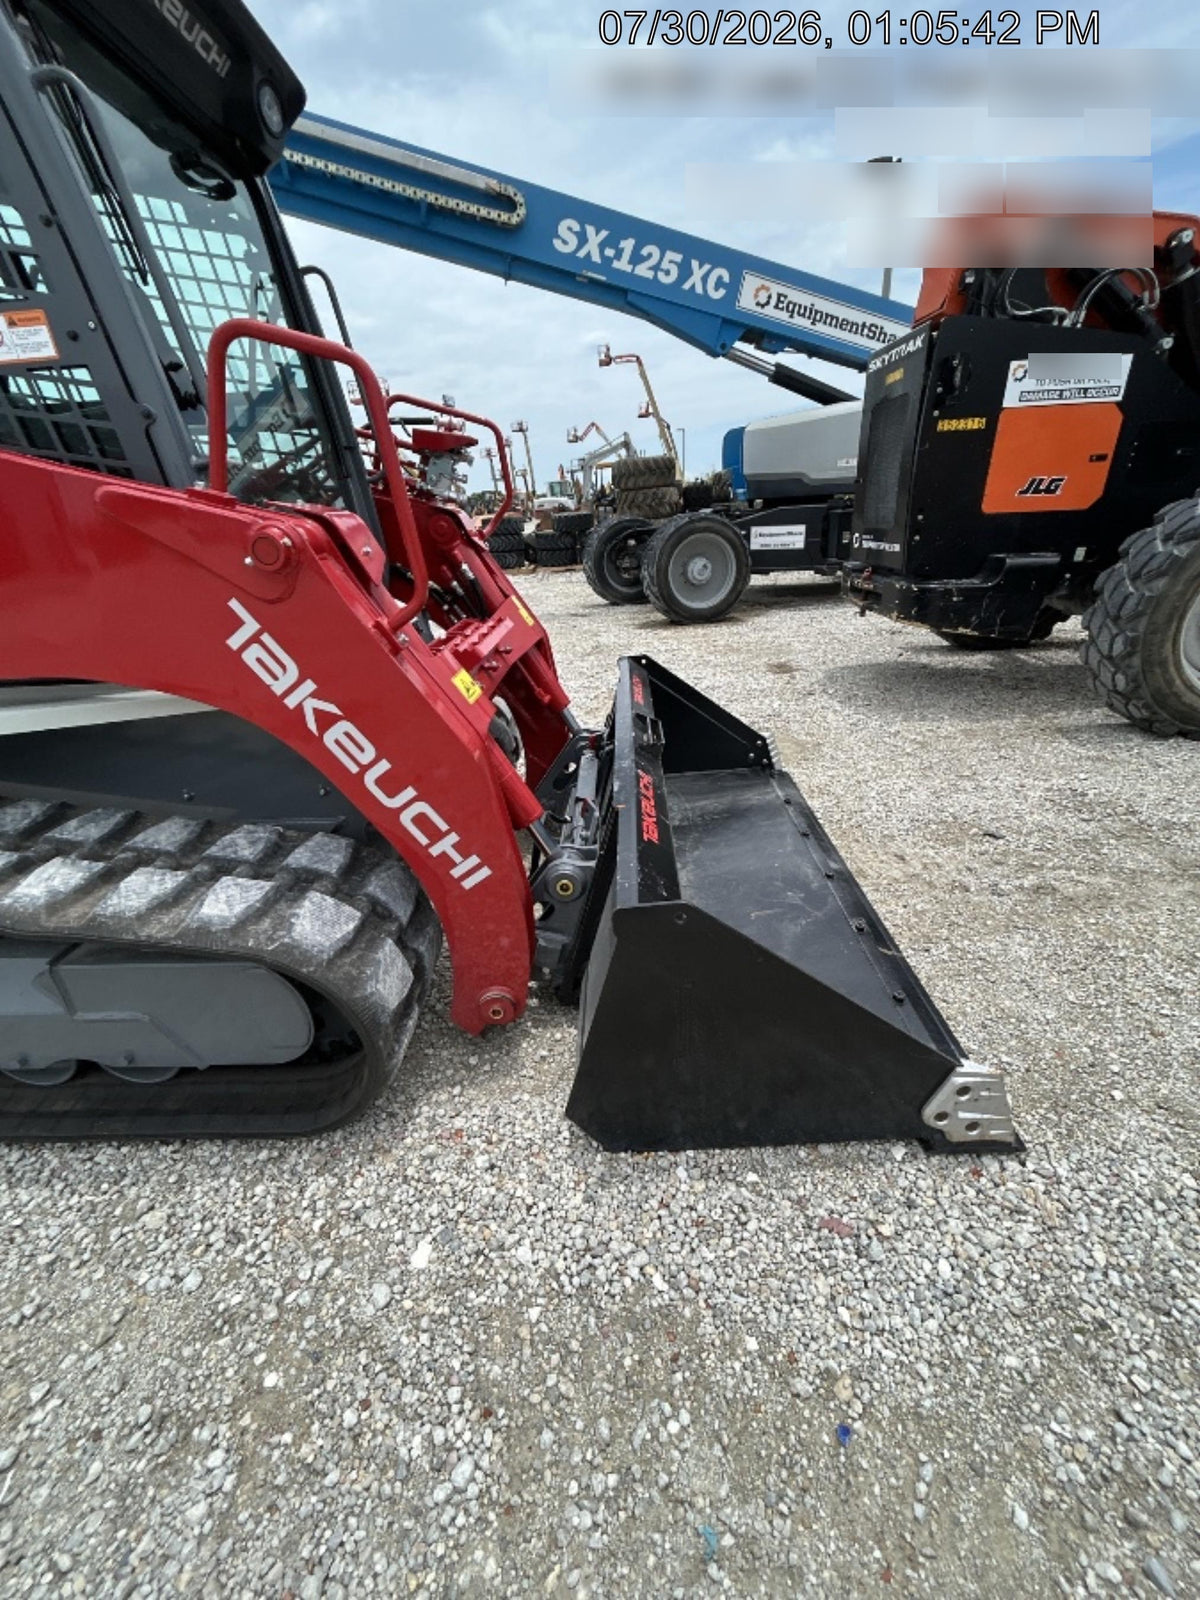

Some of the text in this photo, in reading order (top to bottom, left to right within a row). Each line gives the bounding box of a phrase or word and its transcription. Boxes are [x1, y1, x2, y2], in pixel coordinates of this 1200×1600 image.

[552, 218, 731, 300] SX-125 XC
[1014, 475, 1068, 497] JLG
